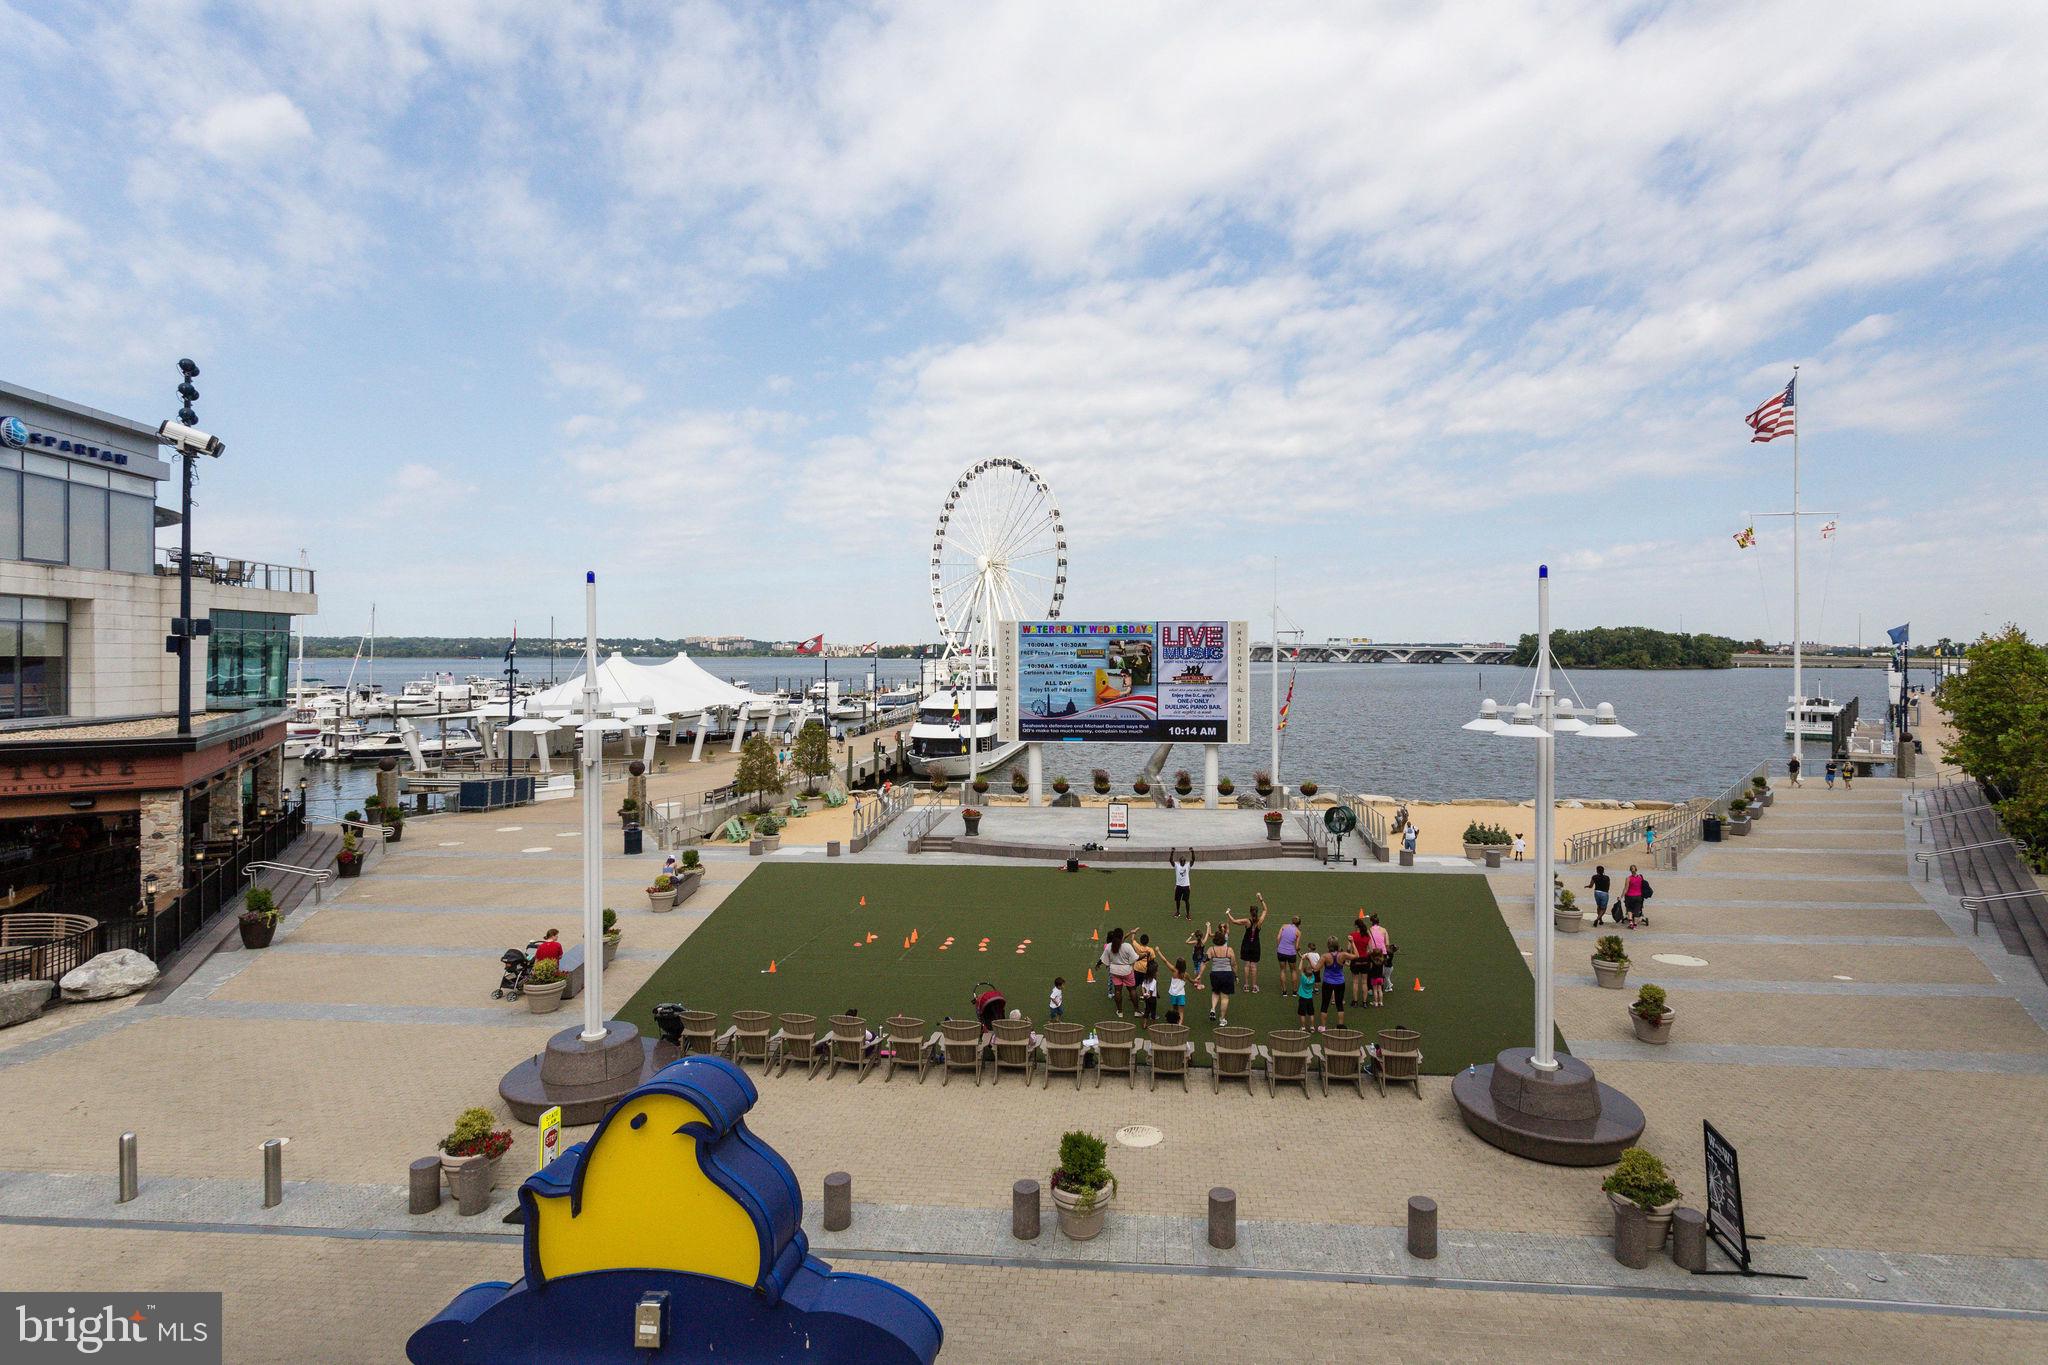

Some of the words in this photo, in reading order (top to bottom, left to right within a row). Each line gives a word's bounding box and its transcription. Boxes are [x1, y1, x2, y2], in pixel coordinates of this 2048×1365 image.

[29, 432, 128, 465] SPARTAN
[1023, 625, 1086, 634] WATERFRONT
[1089, 625, 1153, 634] WEDNESDAYS
[1163, 626, 1224, 647] LIVE
[1163, 647, 1223, 659] MUSIC
[1168, 727, 1197, 735] 10:14
[1200, 727, 1217, 735] AM
